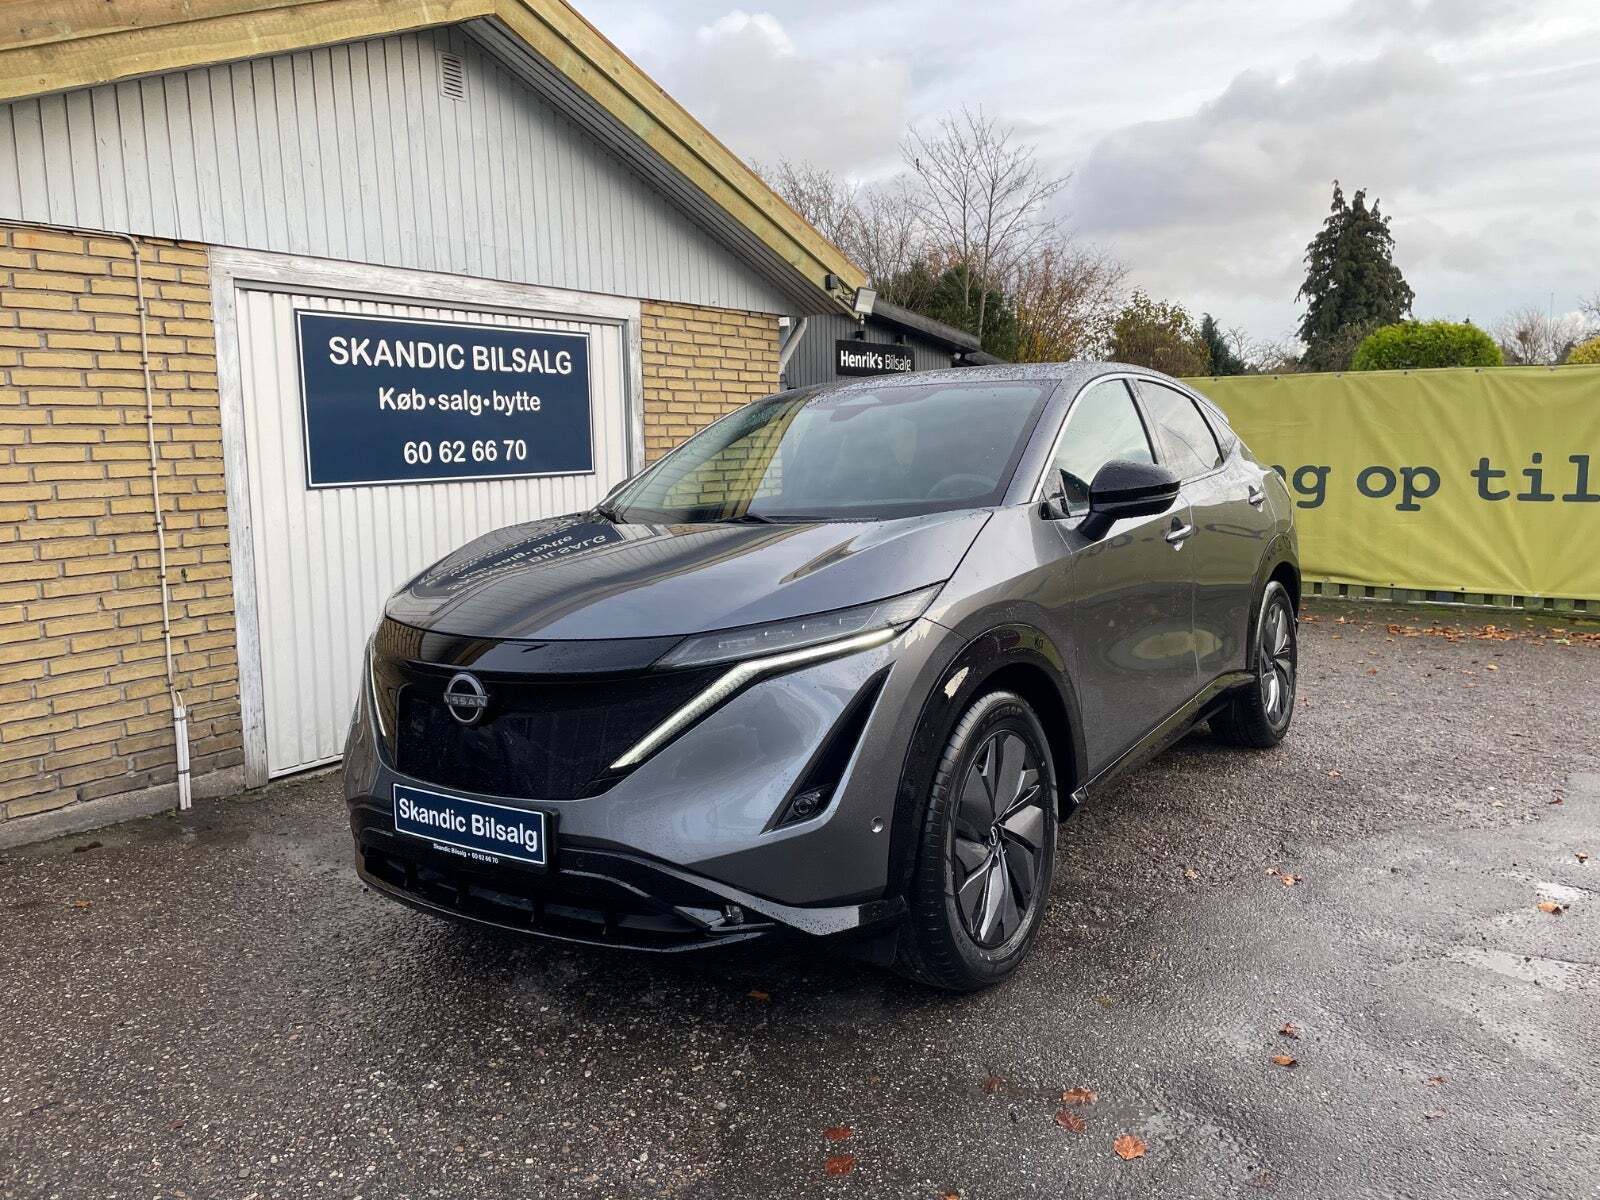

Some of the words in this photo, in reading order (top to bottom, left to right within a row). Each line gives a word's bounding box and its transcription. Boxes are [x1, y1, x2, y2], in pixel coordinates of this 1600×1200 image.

[329, 336, 465, 370] SKANDIC
[473, 345, 572, 375] BILSALG
[840, 350, 883, 369] Henrik's
[885, 354, 911, 373] Bilsalg
[404, 441, 432, 464] 60
[439, 441, 466, 463] 62
[472, 440, 497, 462] 66
[503, 439, 527, 461] 70
[1356, 465, 1441, 512] op
[1470, 452, 1600, 502] til
[443, 693, 487, 707] NISSAN
[399, 798, 467, 833] Skandic
[471, 813, 538, 852] Bilsalg
